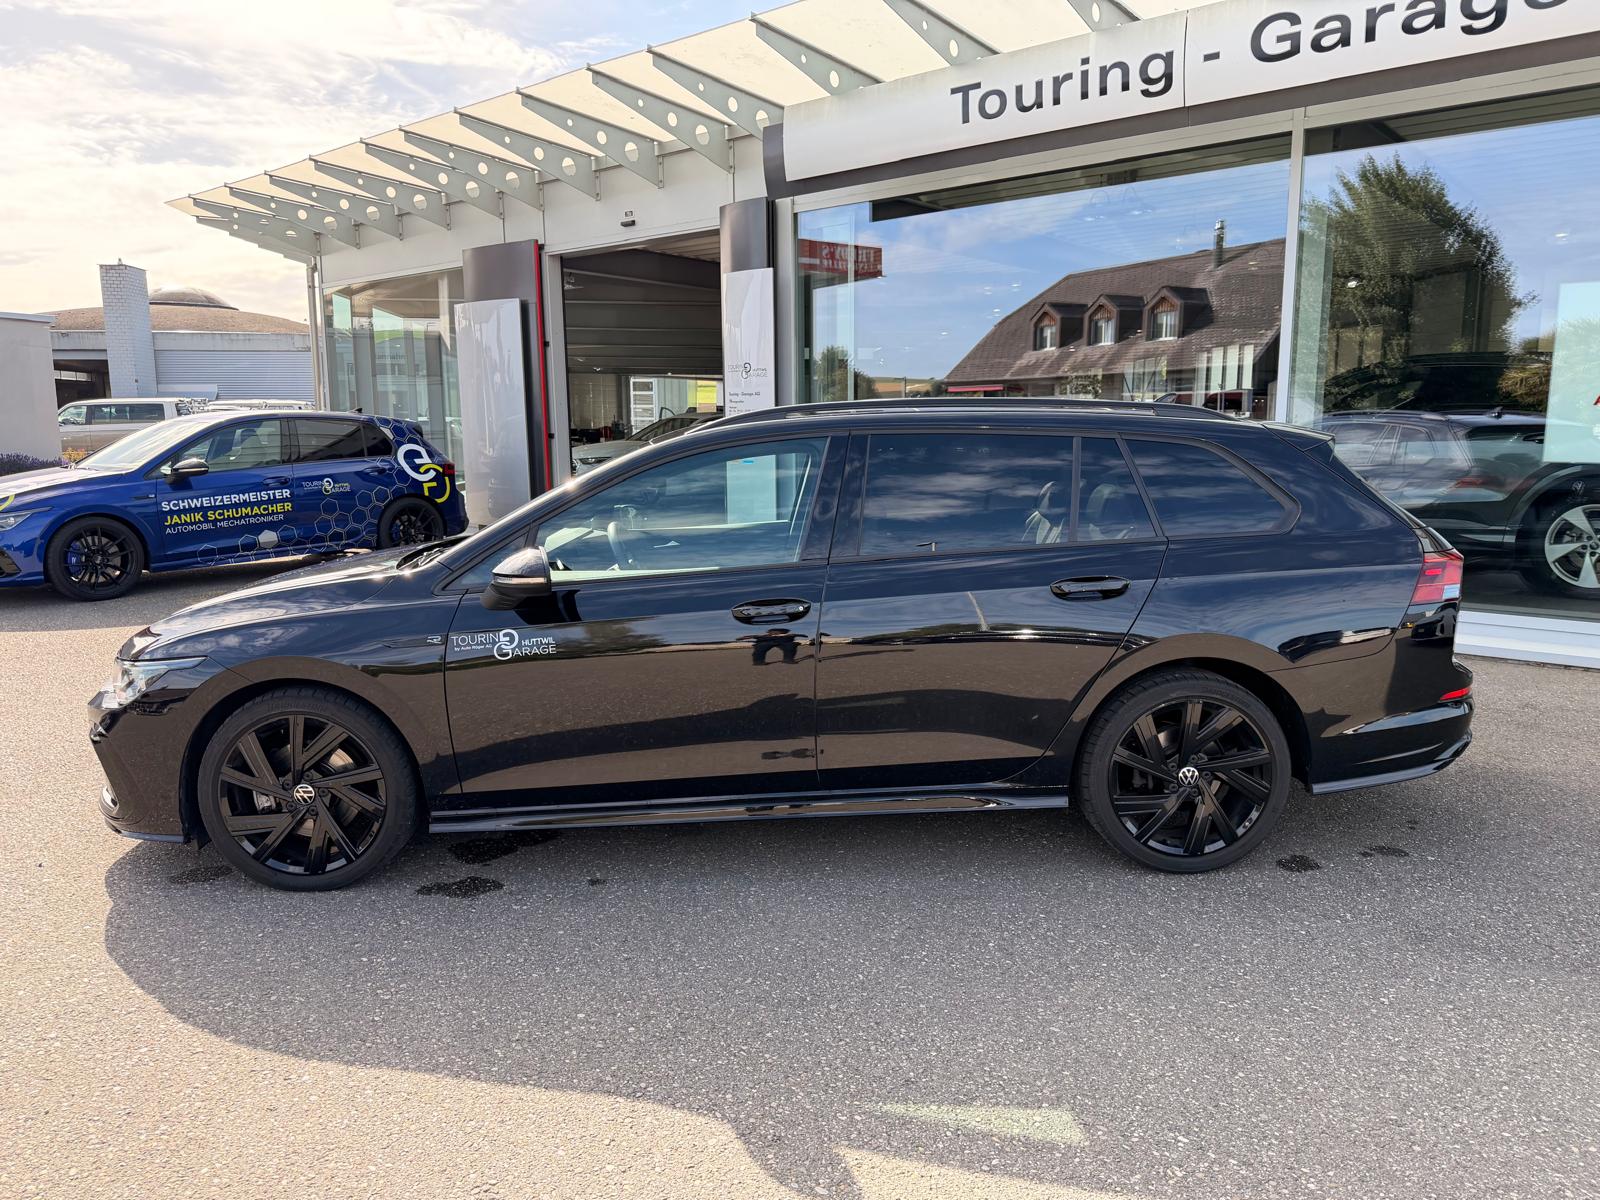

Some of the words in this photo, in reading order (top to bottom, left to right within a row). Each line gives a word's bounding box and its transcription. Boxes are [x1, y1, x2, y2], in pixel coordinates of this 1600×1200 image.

[950, 49, 1174, 125] Touring
[1250, 0, 1569, 63] Garag
[161, 489, 291, 511] SCHWEIZERMEISTER
[164, 512, 205, 526] JANIK
[207, 502, 293, 520] SCHUMACHER
[165, 522, 216, 535] AUTOMOBIL
[217, 513, 285, 528] MECHATRONIKER
[521, 637, 556, 646] HUTTWIL
